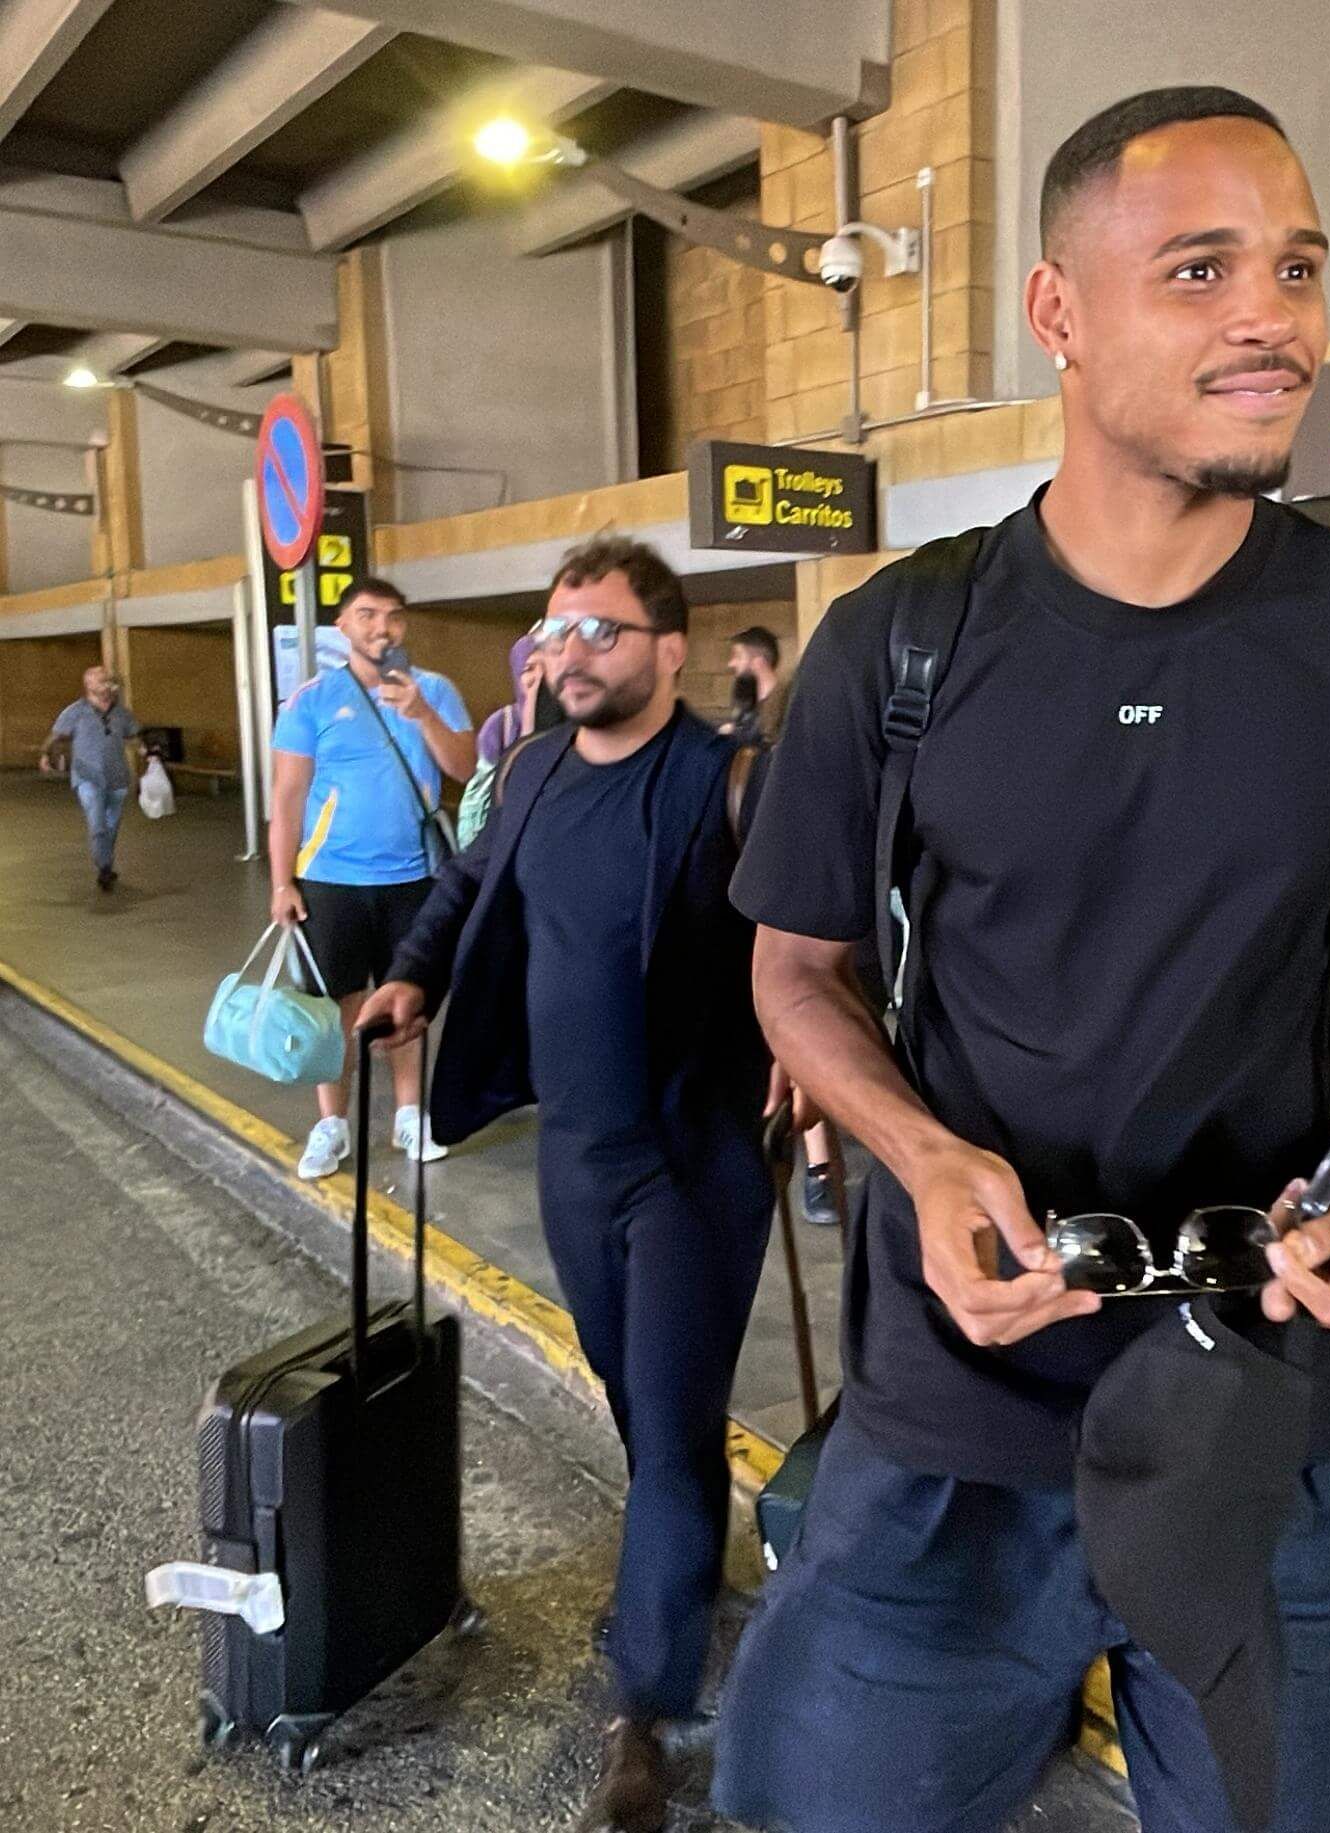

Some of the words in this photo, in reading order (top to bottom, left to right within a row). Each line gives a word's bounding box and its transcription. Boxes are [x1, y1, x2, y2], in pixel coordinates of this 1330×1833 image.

[774, 468, 844, 498] Trolleys
[775, 501, 854, 529] Carritos
[1118, 705, 1163, 724] OFF
